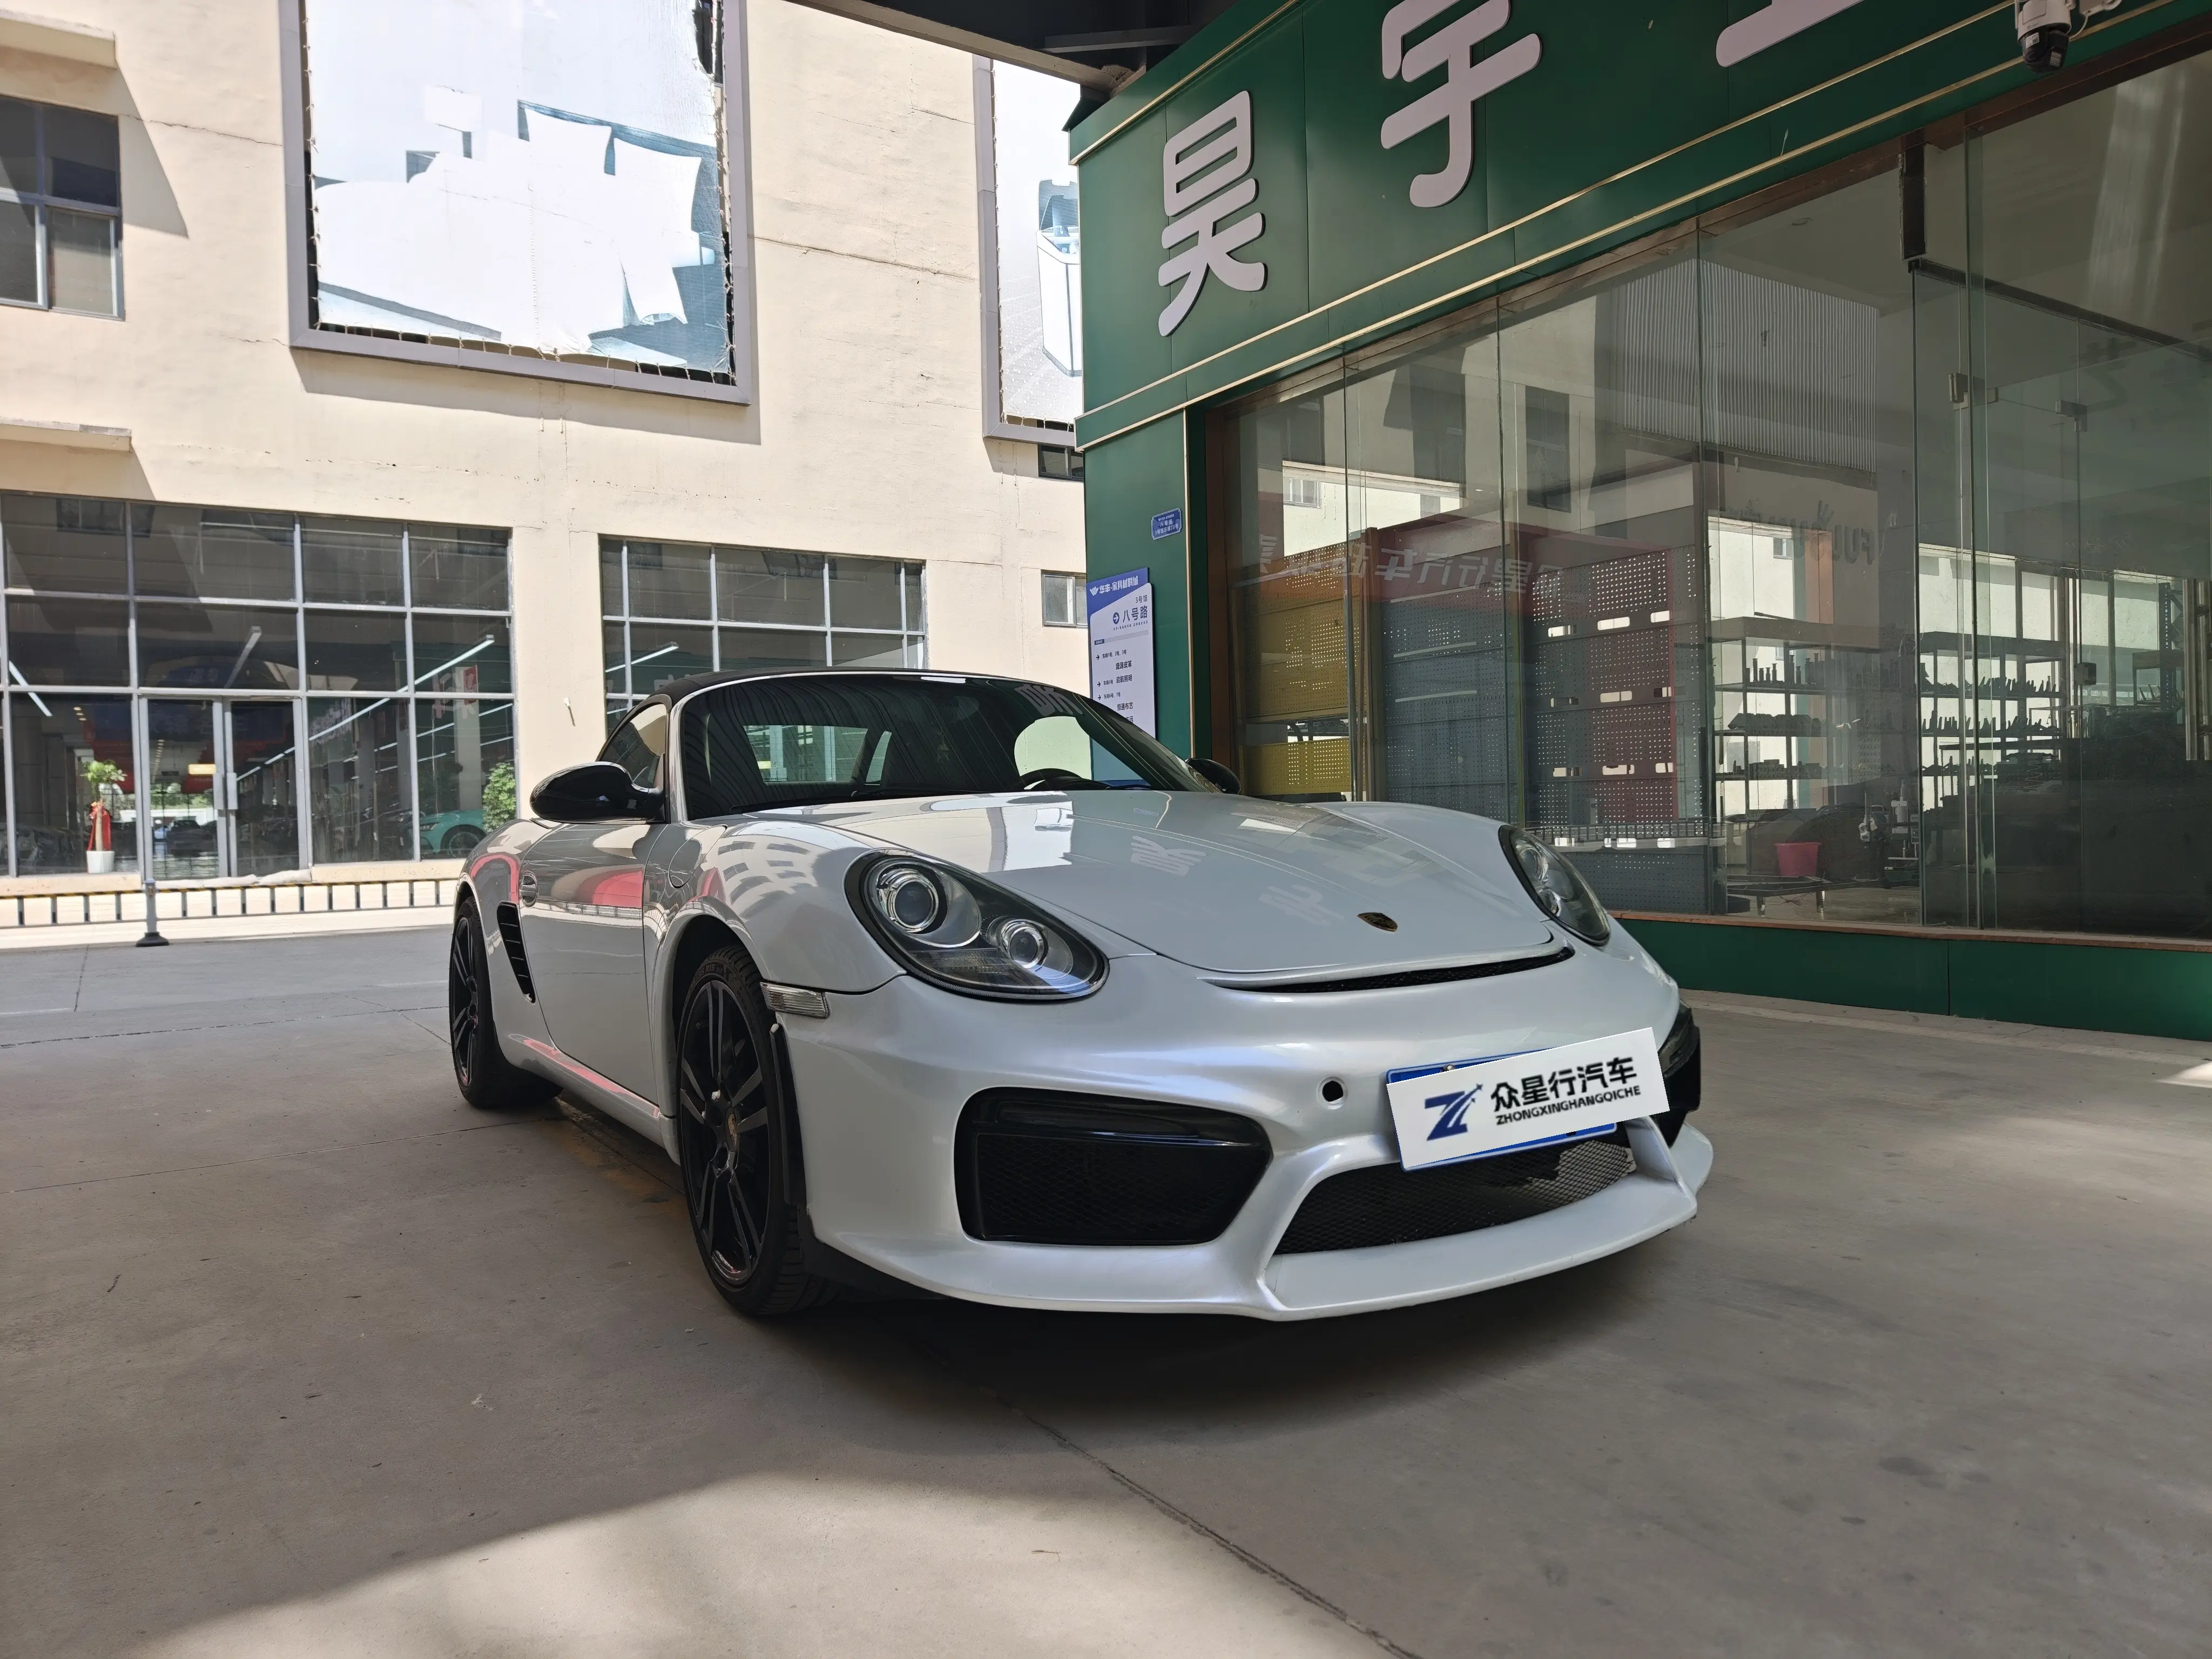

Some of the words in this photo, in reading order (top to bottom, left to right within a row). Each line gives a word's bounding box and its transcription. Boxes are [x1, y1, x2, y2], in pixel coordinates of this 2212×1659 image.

[1123, 605, 1148, 623] 八号路
[1116, 660, 1132, 670] 盛源皮革
[1116, 675, 1132, 683] 启航照明
[1117, 702, 1134, 711] 恒通布艺
